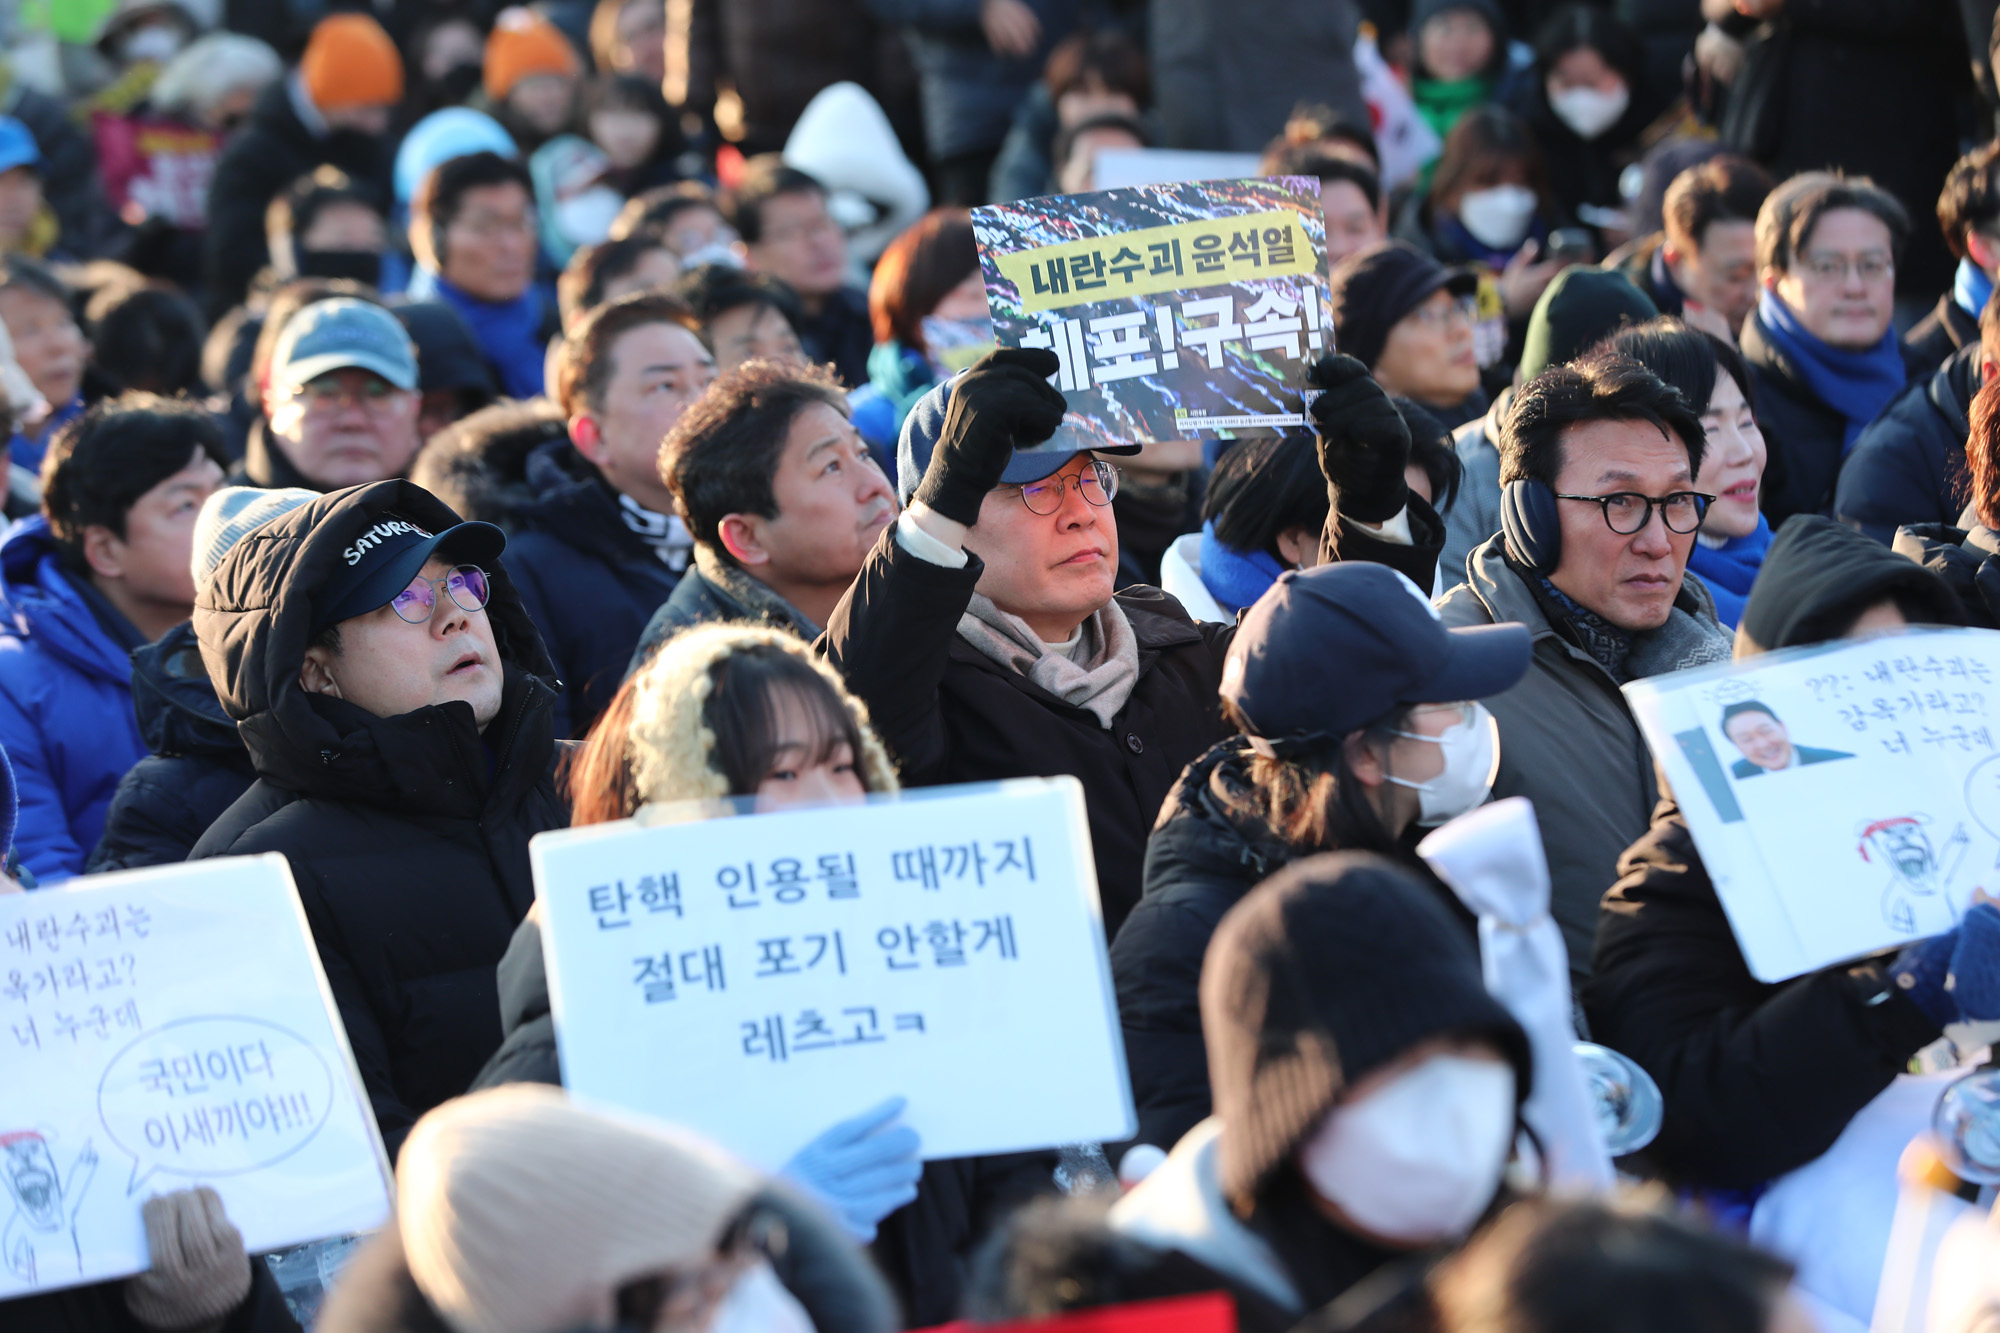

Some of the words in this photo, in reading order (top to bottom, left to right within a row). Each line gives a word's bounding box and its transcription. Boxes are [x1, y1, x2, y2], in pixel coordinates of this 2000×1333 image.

[1029, 238, 1184, 295] 내란수괴
[1192, 224, 1296, 273] 윤석열
[1863, 655, 1992, 686] 내란수괴는
[1880, 730, 1913, 756] 너
[1921, 724, 1995, 752] 누군데
[588, 871, 684, 931] 탄핵
[715, 852, 861, 910] 인용될
[891, 836, 1037, 892] 때까지
[5, 904, 151, 955] 내란수괴는
[632, 943, 728, 1005] 절대
[755, 929, 848, 977] 포기
[876, 914, 1019, 971] 안할게
[11, 1014, 42, 1052] 너
[740, 1004, 928, 1063] 레츠고ㅋ
[139, 1037, 275, 1099] 국민이다
[144, 1091, 314, 1154] 이새끼야!!!
